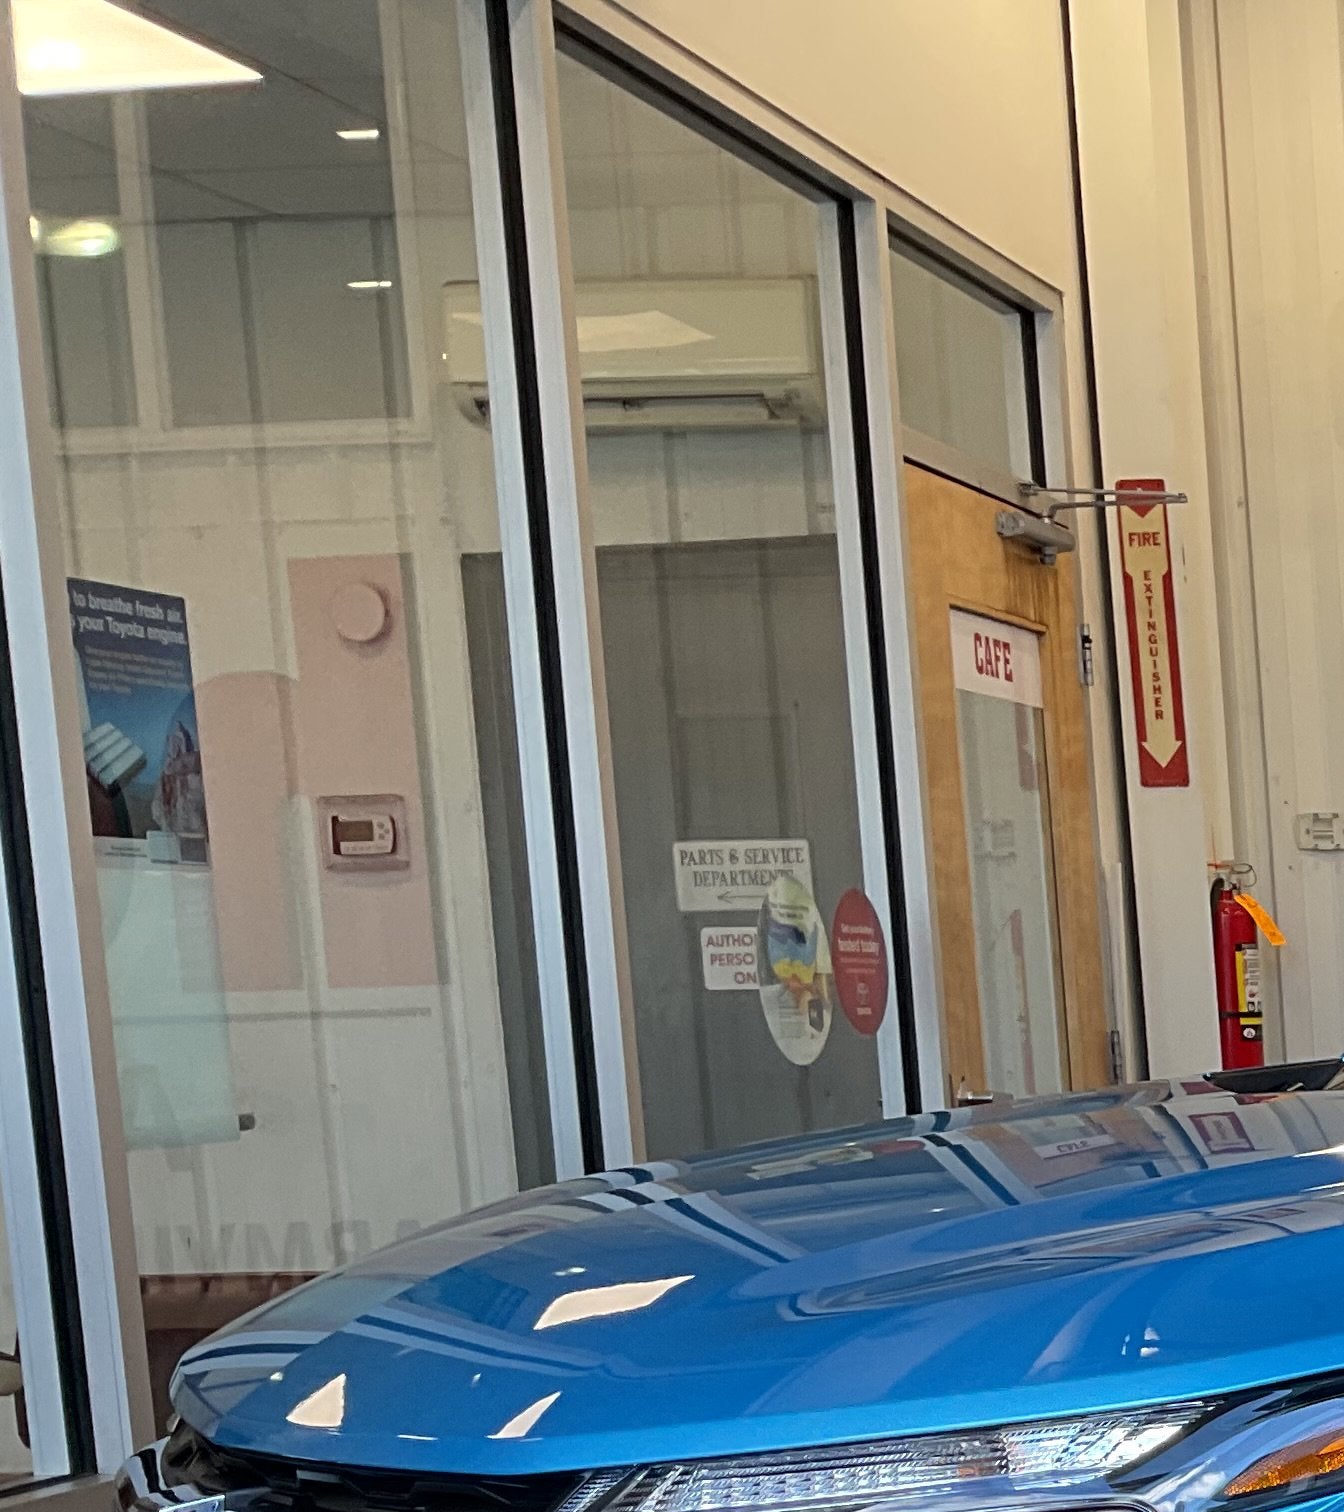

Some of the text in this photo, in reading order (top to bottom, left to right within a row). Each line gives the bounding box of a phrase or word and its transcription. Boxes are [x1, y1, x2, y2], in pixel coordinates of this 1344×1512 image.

[1128, 531, 1161, 548] FIRE
[88, 593, 133, 616] breathe
[135, 600, 164, 620] fresh
[78, 615, 104, 632] your
[105, 616, 146, 639] Toyota
[973, 632, 1014, 683] CAFE
[1143, 570, 1164, 721] EXTINGUISHER
[680, 848, 724, 866] PARTS
[744, 847, 805, 865] SERVICE
[706, 933, 757, 948] AUTHO
